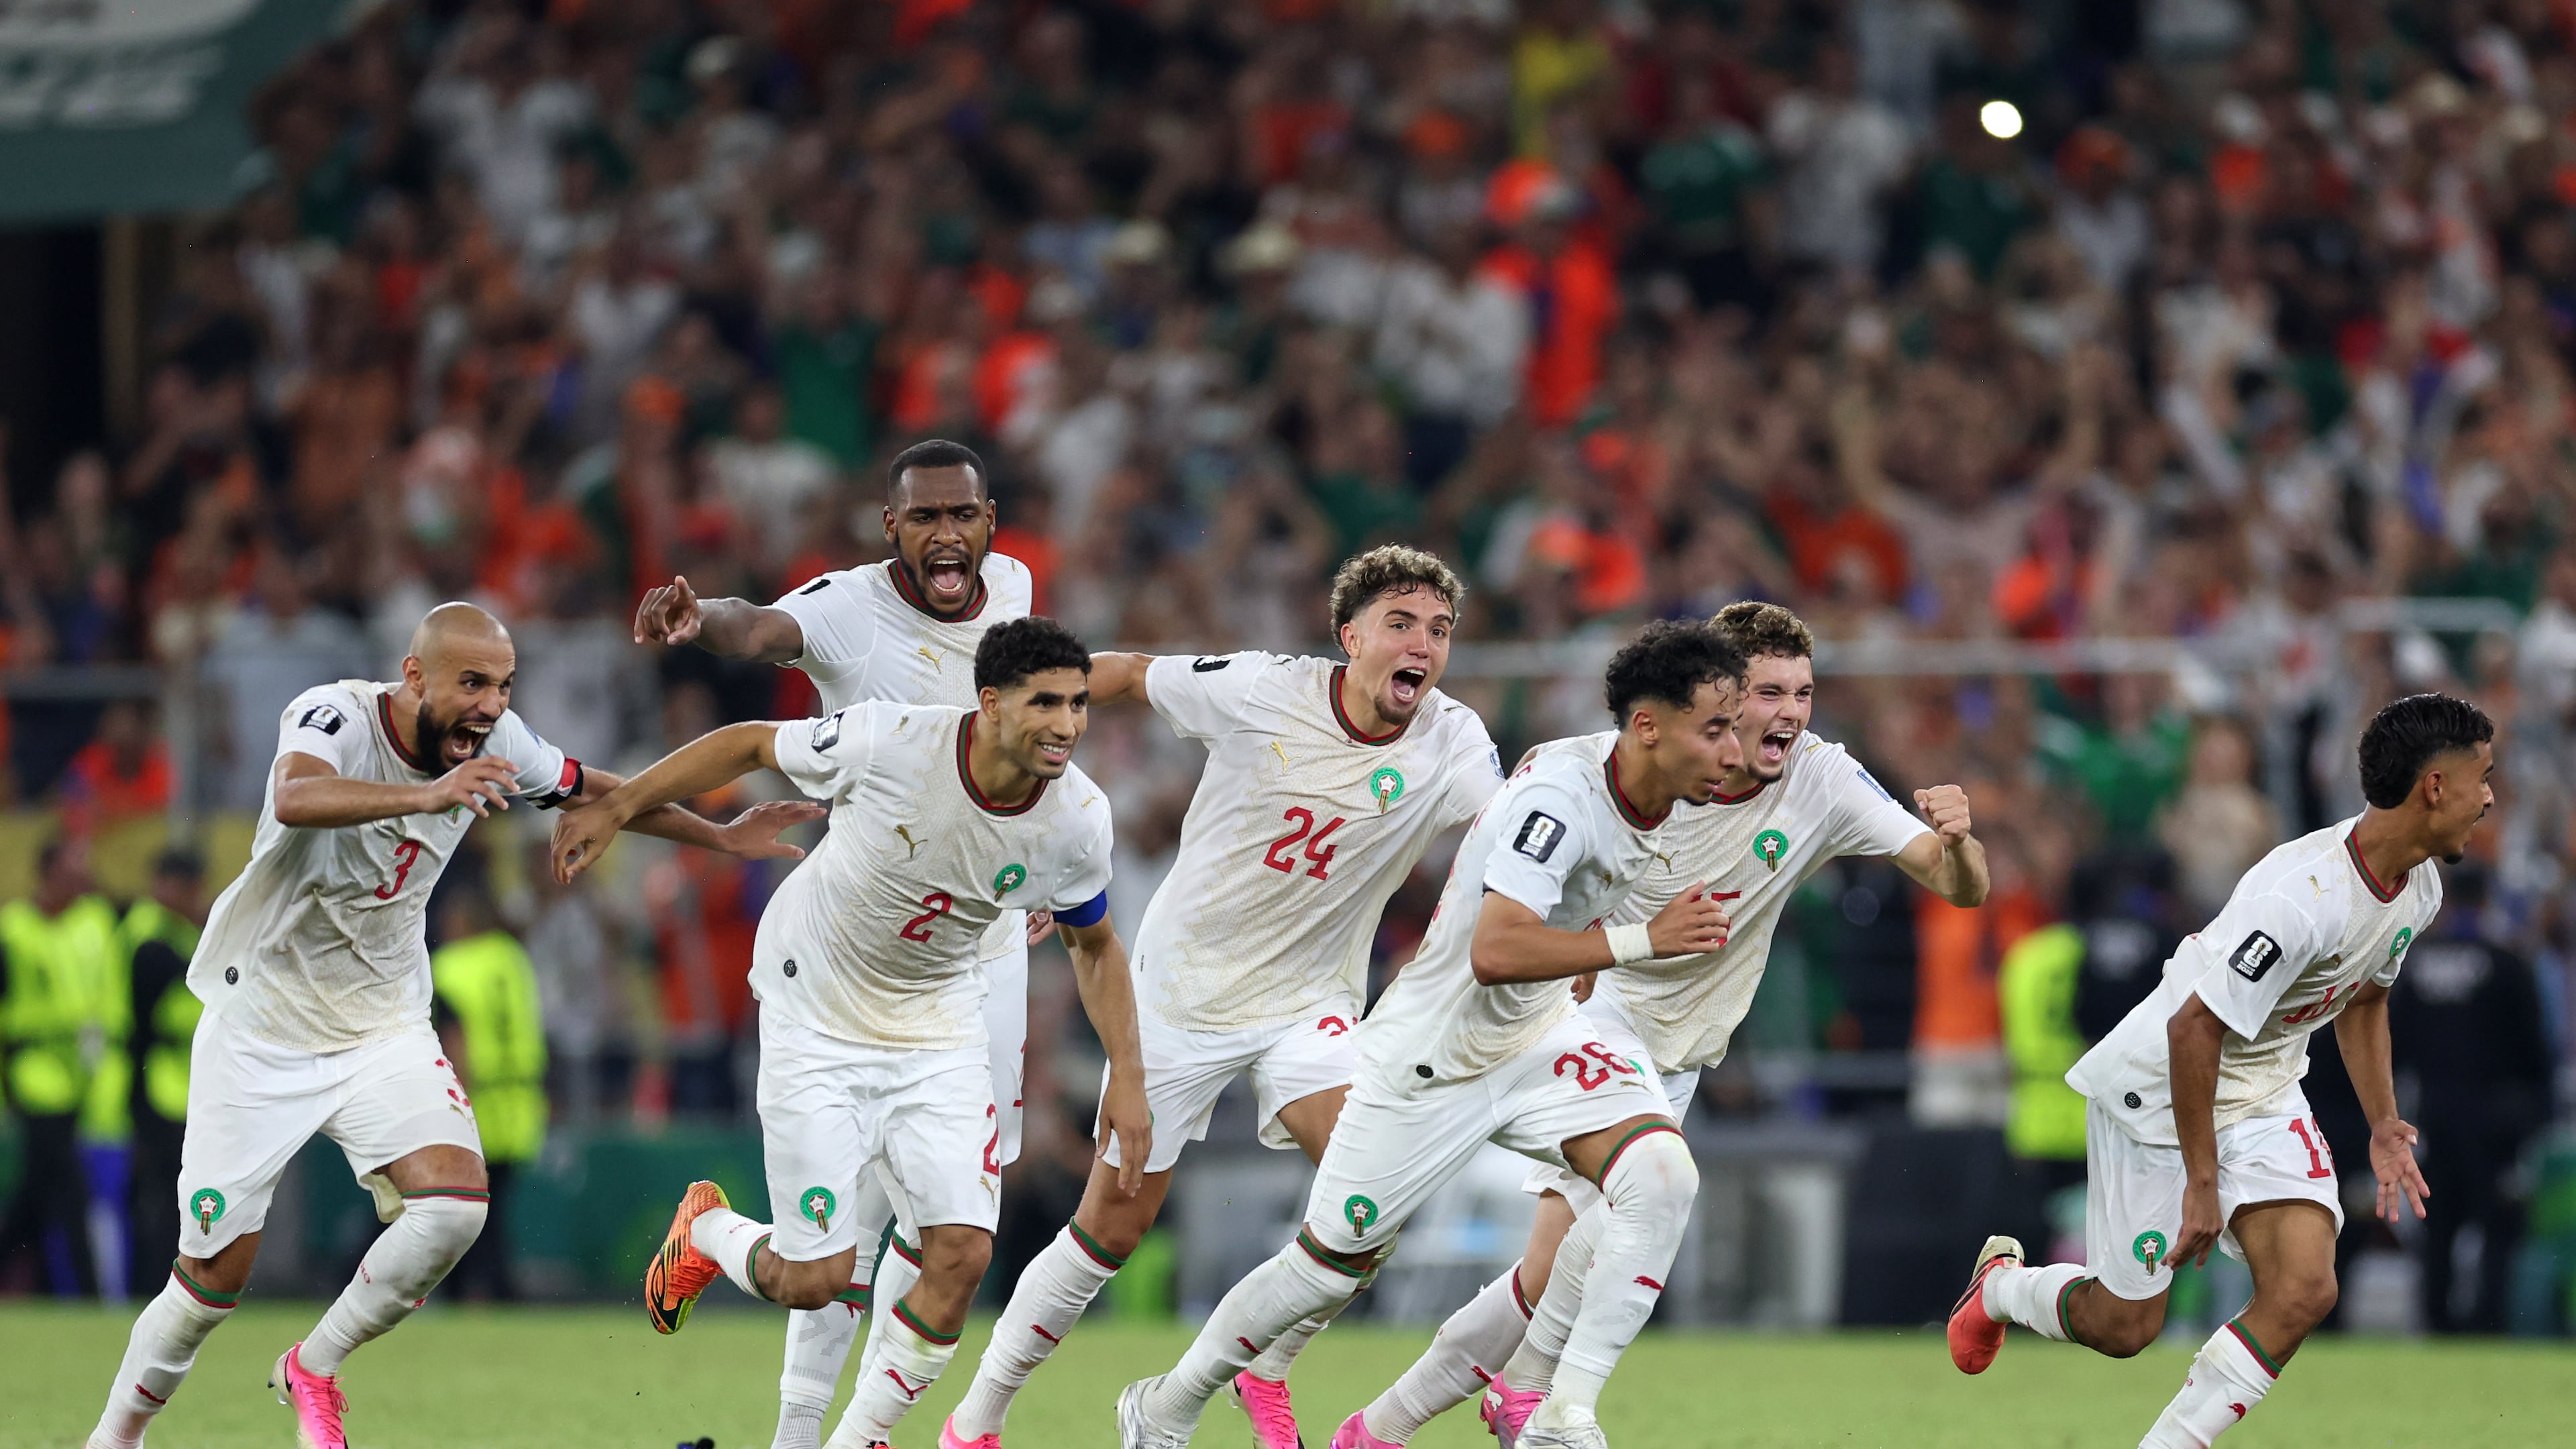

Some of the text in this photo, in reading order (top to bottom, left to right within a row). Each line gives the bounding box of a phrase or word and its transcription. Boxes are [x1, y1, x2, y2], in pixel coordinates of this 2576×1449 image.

[374, 839, 421, 900] 3
[1263, 806, 1346, 881] 24
[899, 892, 953, 944] 2
[1554, 1042, 1638, 1091] 26
